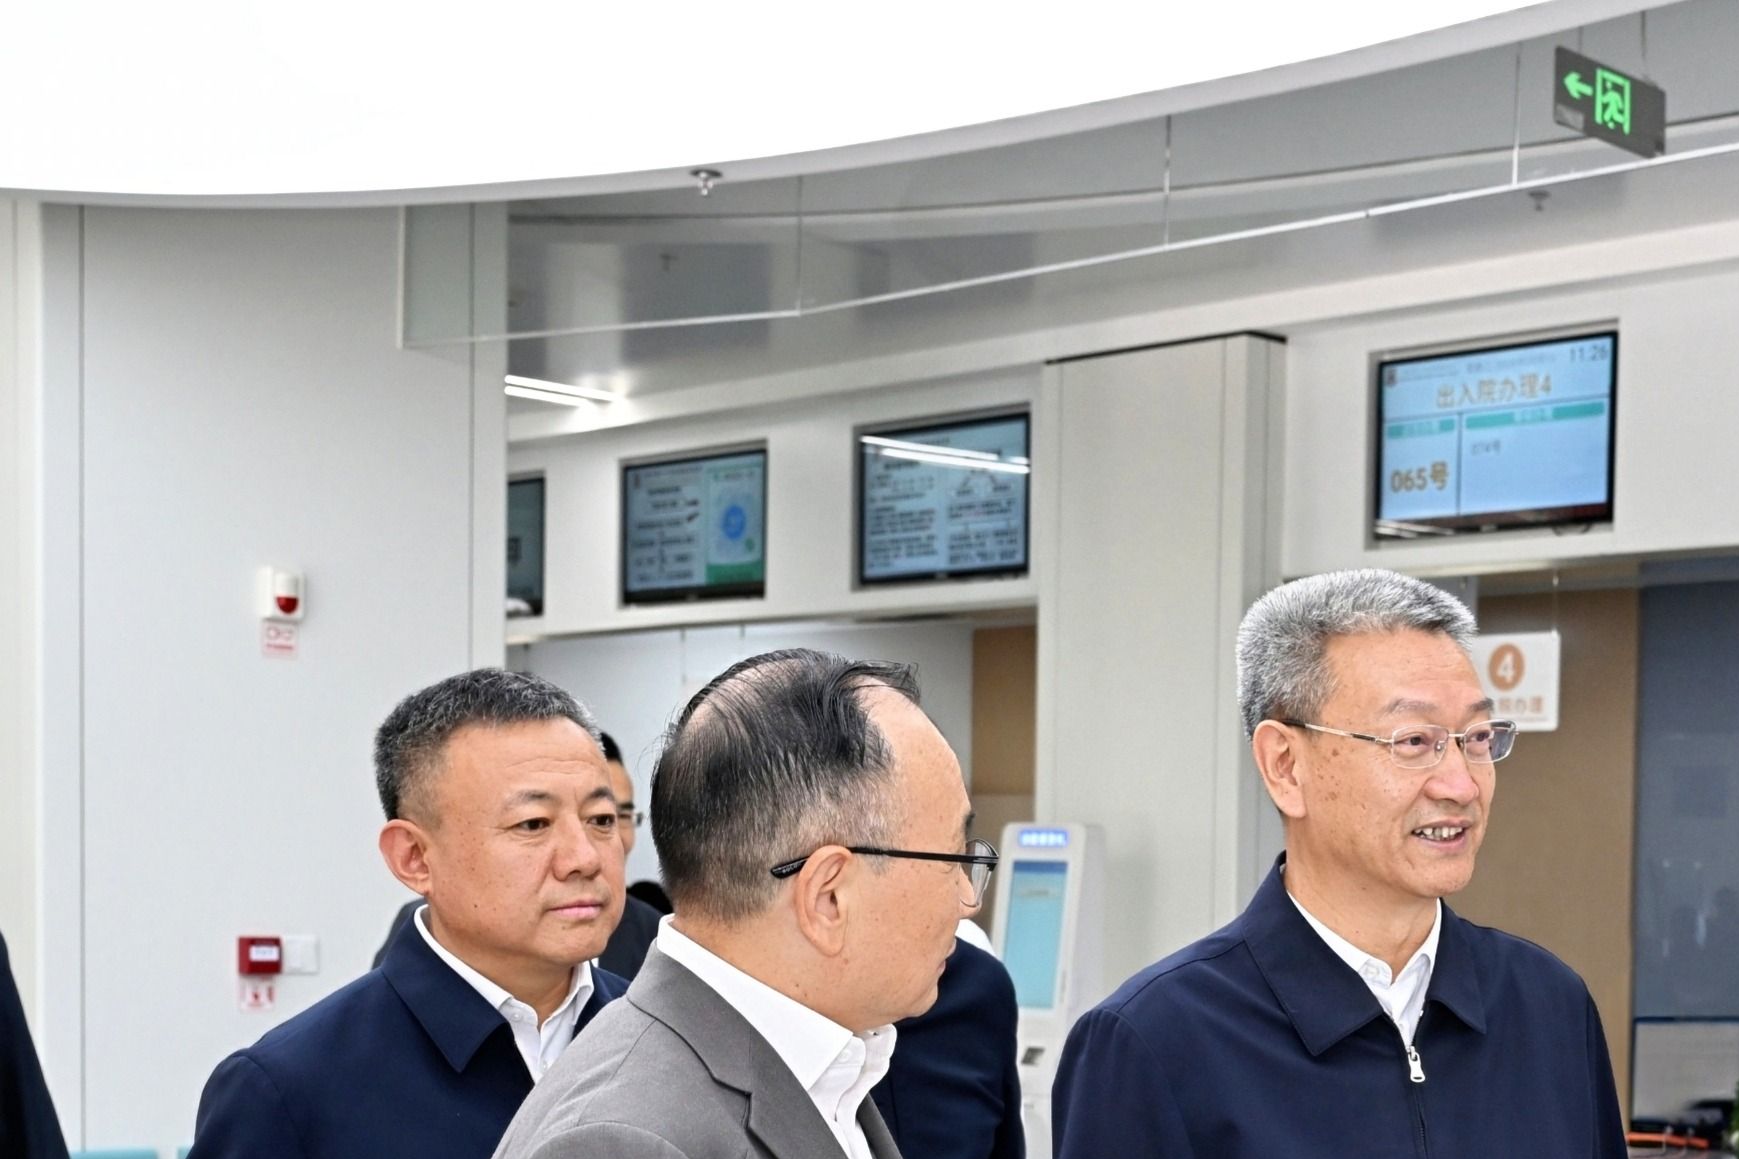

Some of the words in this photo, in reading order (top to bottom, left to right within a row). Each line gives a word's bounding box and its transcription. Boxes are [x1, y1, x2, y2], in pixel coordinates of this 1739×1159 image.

[1435, 373, 1553, 408] 出入院办理4
[1390, 461, 1449, 493] 065号
[1496, 652, 1516, 684] 4
